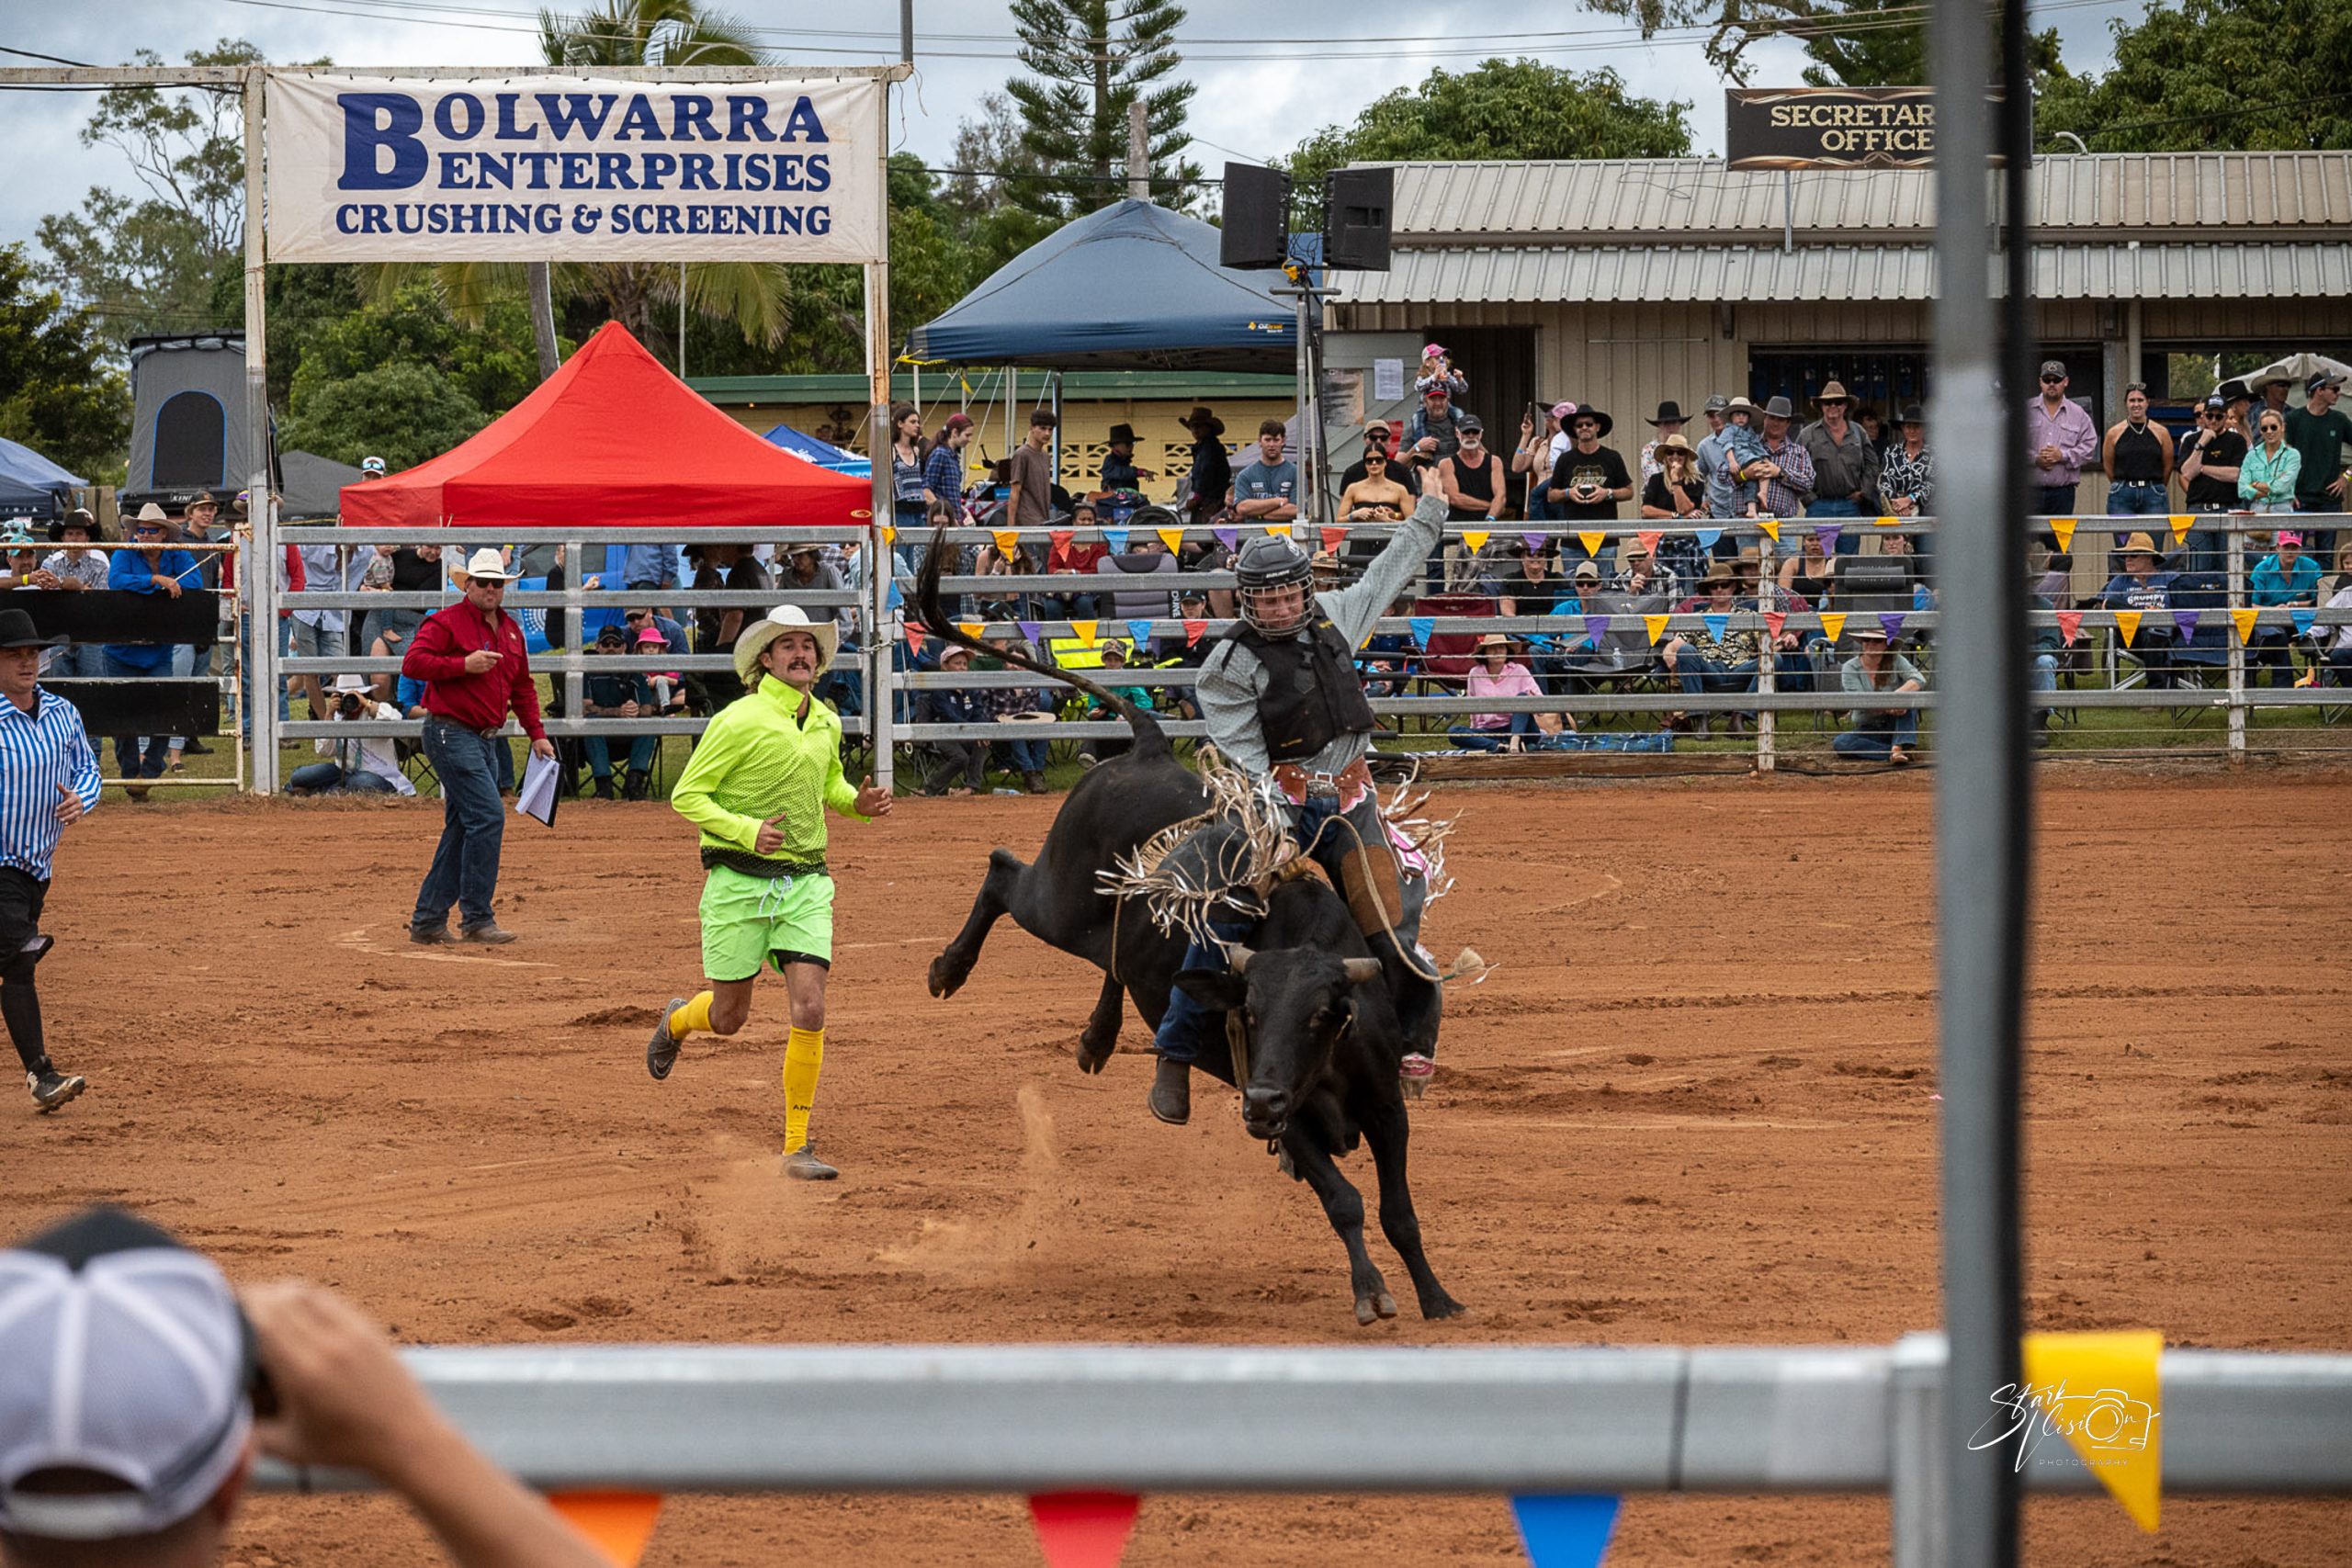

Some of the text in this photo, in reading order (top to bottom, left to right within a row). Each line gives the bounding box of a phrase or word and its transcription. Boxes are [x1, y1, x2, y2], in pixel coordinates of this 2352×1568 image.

[1770, 104, 1939, 127] SECRETAR
[337, 92, 830, 190] BOLWARRA
[1820, 129, 1937, 152] OFFICE
[437, 152, 831, 192] ENTERPRISES
[335, 203, 831, 235] CRUSHING & SCREENING
[2127, 593, 2165, 605] GRUMPY
